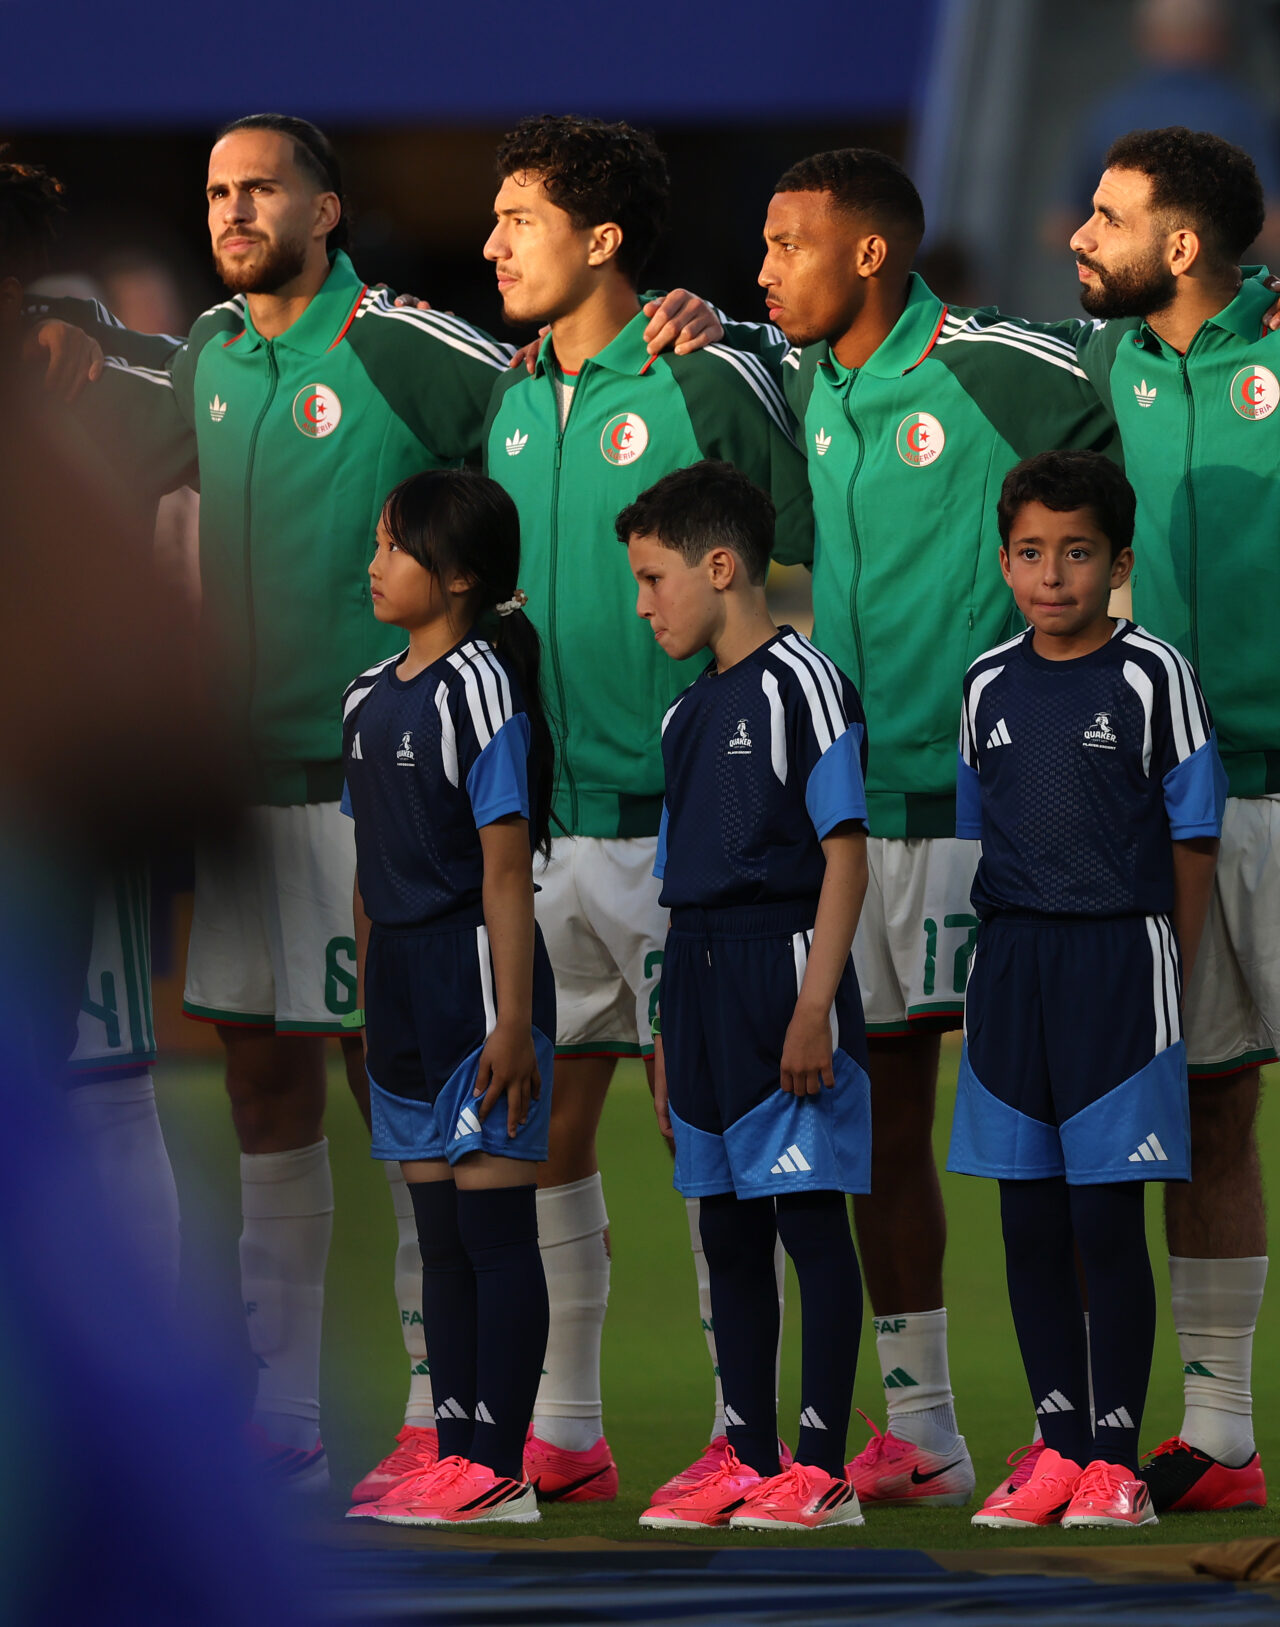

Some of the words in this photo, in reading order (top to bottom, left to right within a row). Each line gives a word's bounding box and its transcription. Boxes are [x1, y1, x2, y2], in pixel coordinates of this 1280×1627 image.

[1239, 403, 1273, 417] ALGERIA
[302, 422, 334, 434] ALGERIA
[606, 448, 637, 461] ALGERIA
[905, 449, 937, 463] ALGERIA
[729, 738, 752, 748] QUAKER
[1084, 731, 1117, 743] QUAKER
[923, 913, 981, 995] 17
[325, 936, 358, 1015] 6
[402, 1310, 424, 1326] FA
